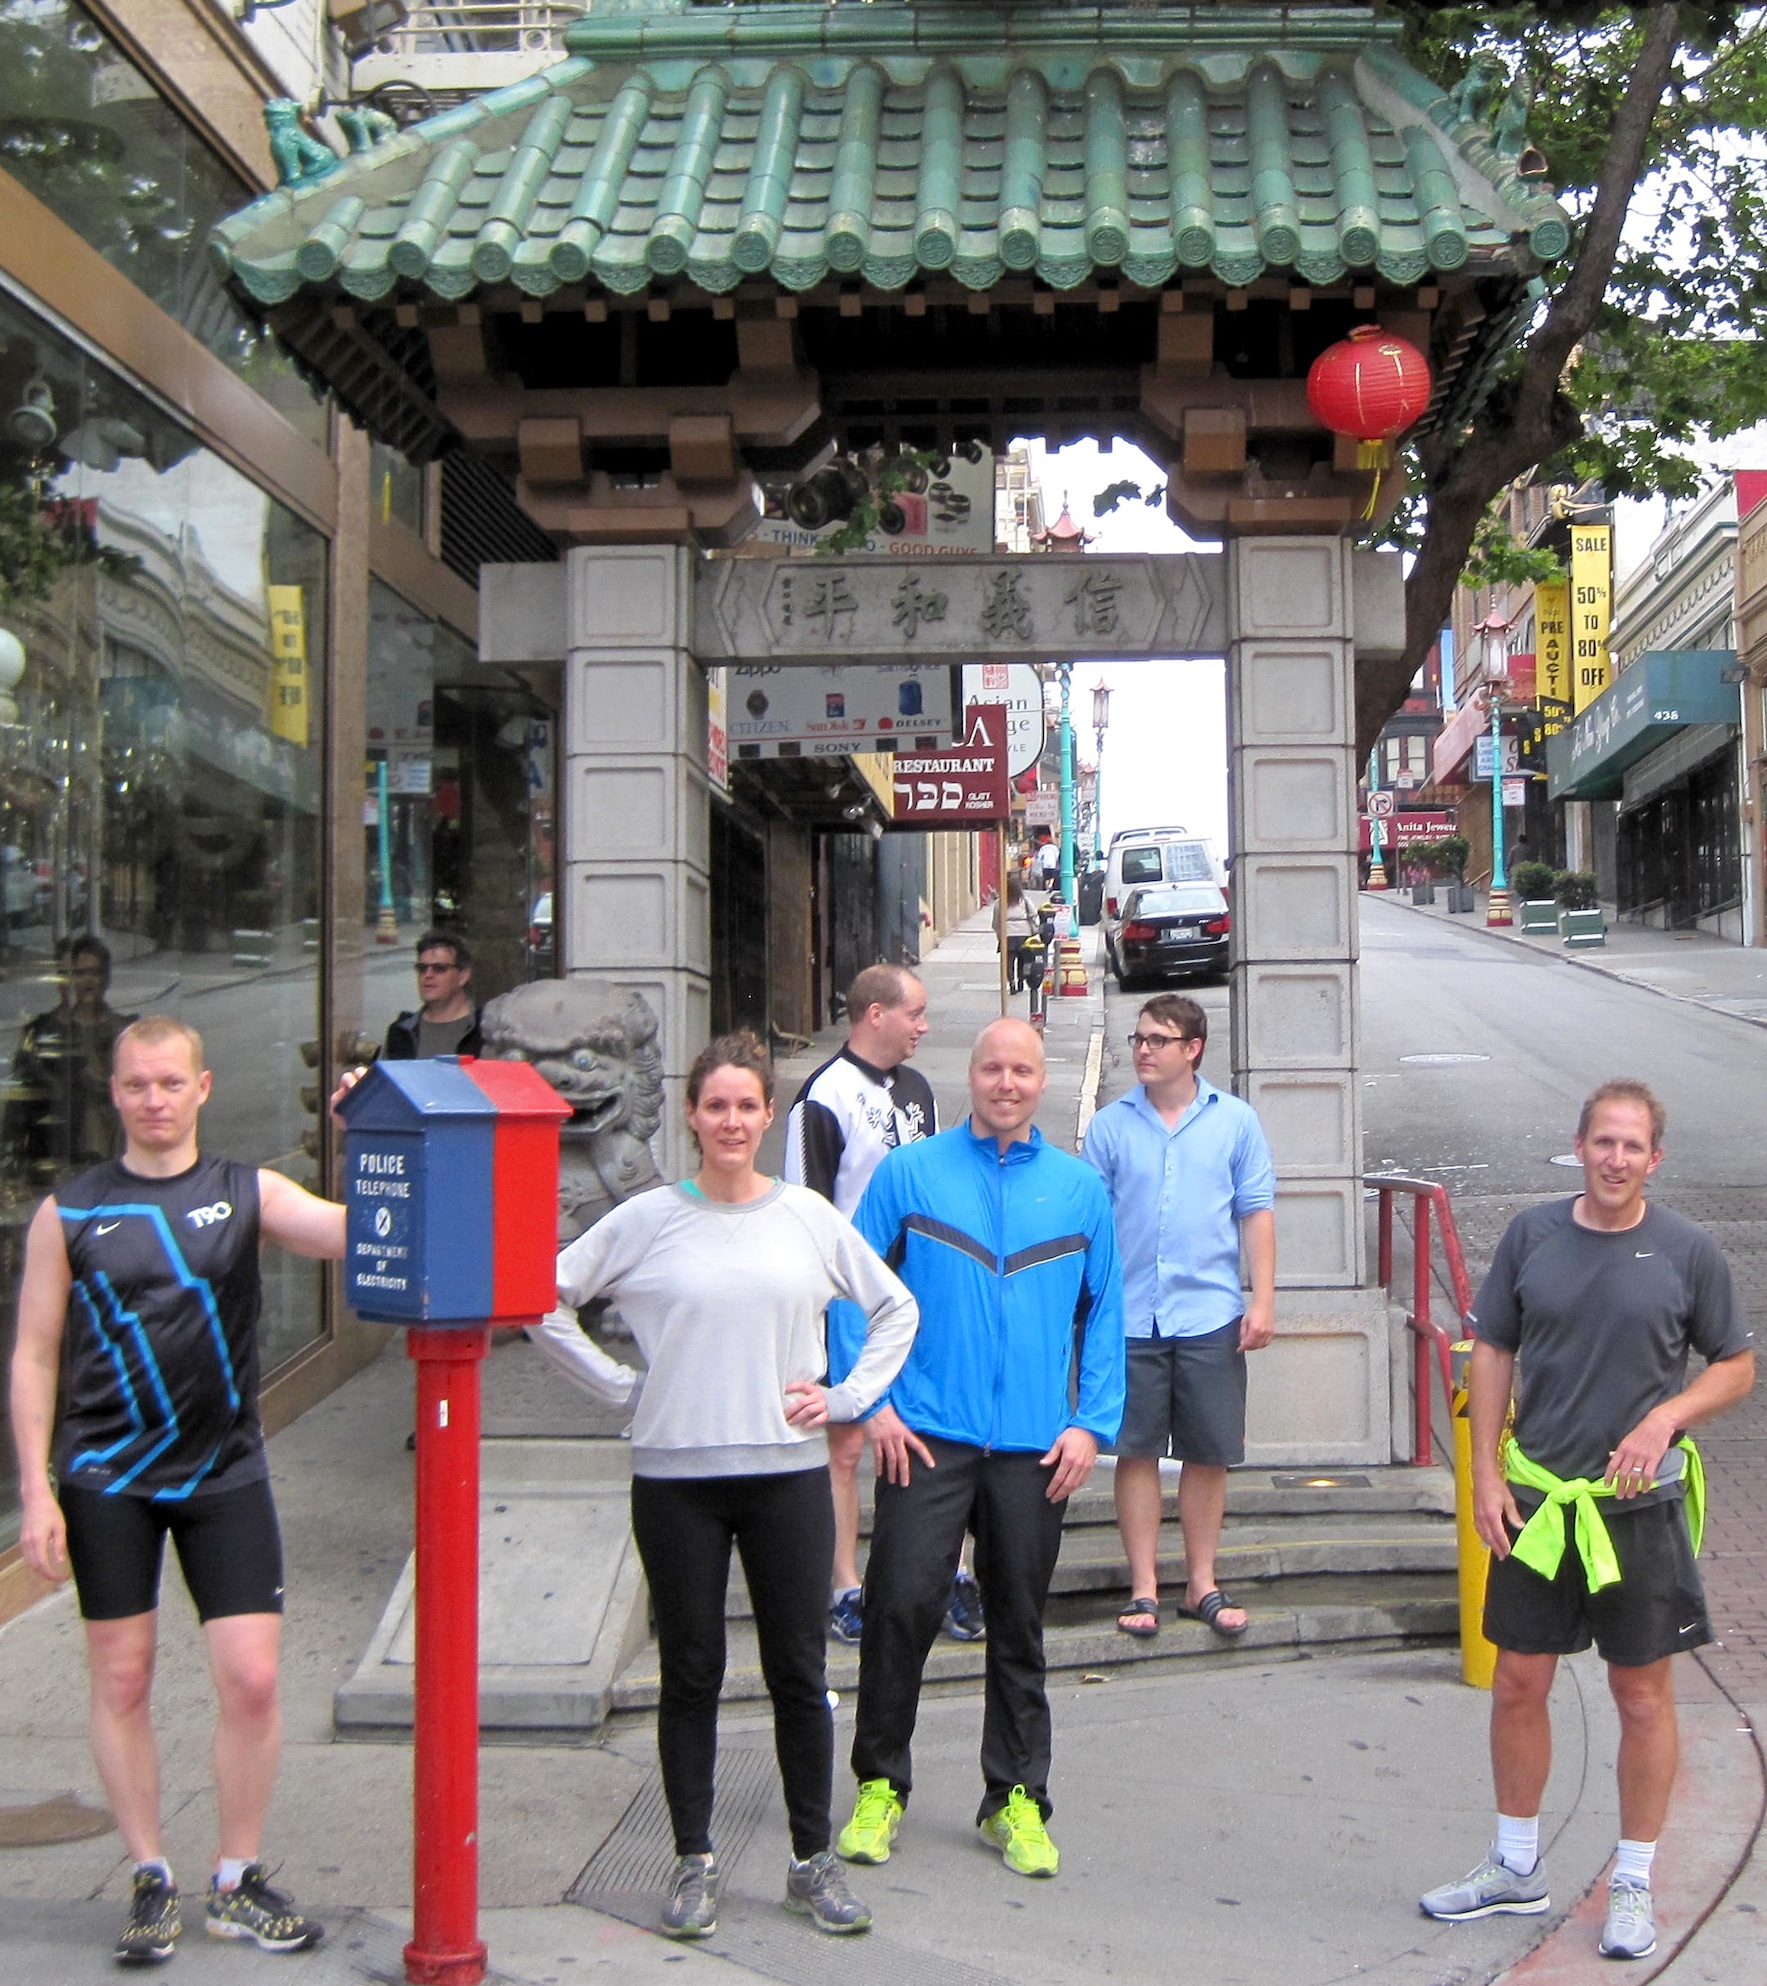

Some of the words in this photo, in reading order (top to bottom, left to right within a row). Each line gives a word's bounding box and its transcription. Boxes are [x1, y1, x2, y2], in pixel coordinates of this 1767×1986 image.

[1576, 537, 1607, 552] SALE
[1577, 586, 1607, 604] 50%
[1541, 621, 1565, 635] PRE
[1584, 615, 1598, 630] TO
[1581, 668, 1605, 686] OFF
[730, 719, 790, 734] CITIZEN
[895, 717, 942, 728] DELSEY
[814, 742, 861, 754] SONY
[893, 758, 995, 774] RESTAURANT
[1396, 821, 1423, 832] Anita
[360, 1153, 405, 1175] POLICE
[356, 1179, 411, 1199] TELEPHONE
[356, 1243, 409, 1260] DEPARTMENT
[376, 1260, 388, 1272] OF
[356, 1272, 408, 1291] ELECTRICITY
